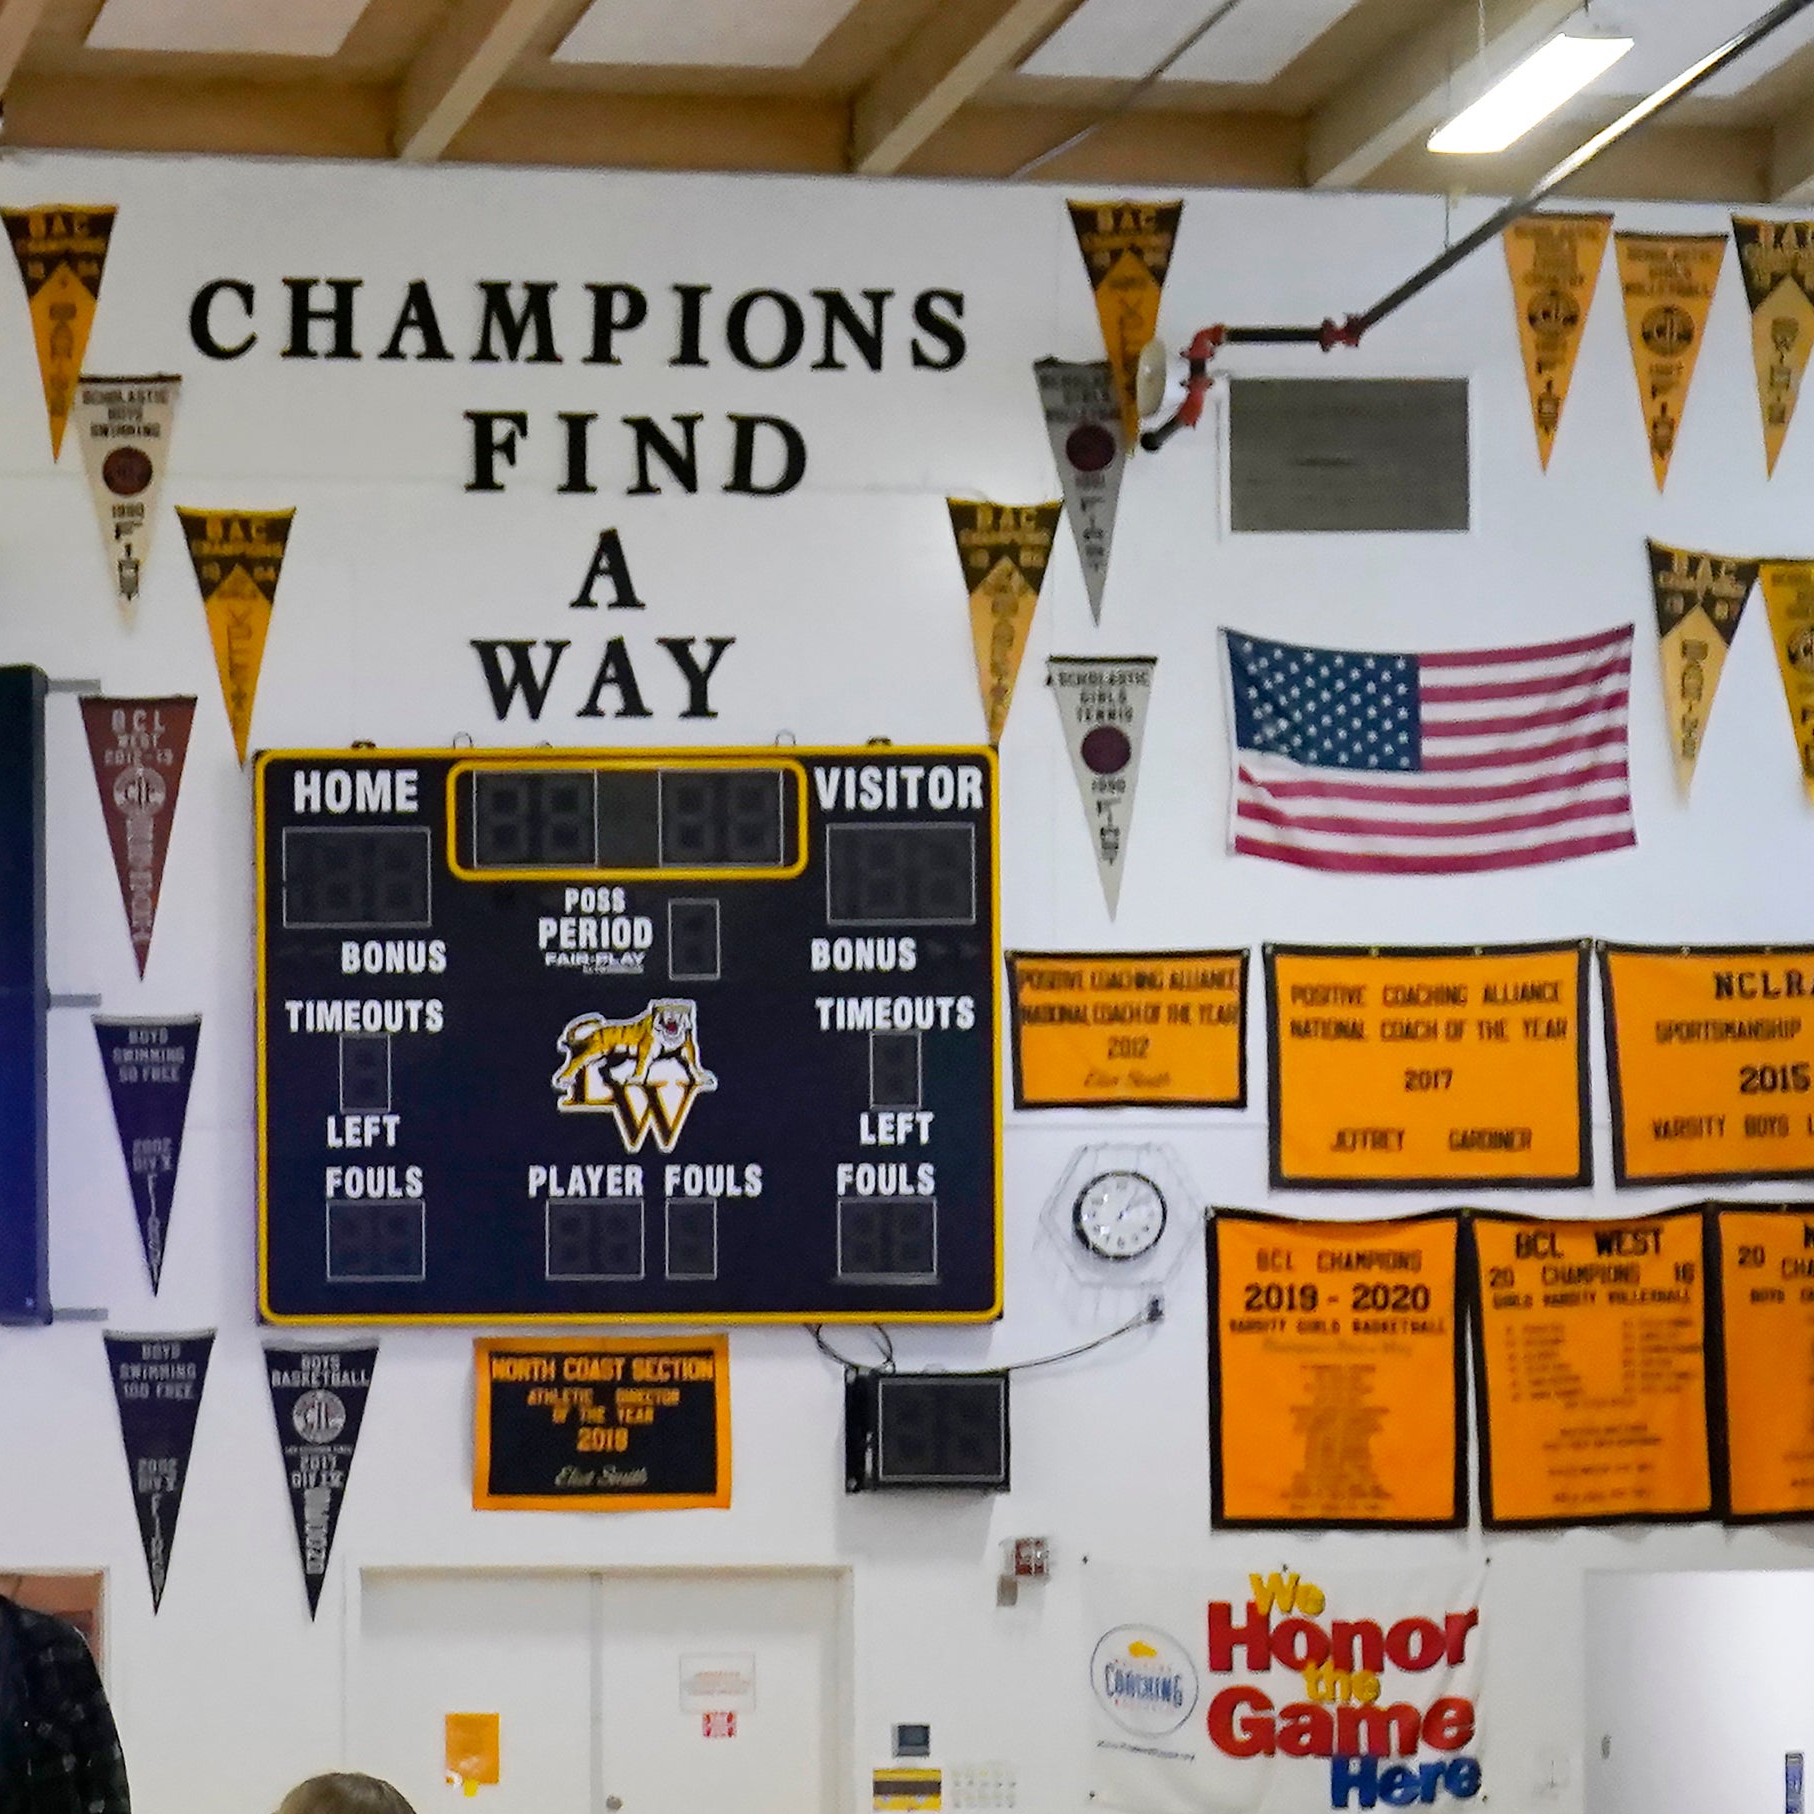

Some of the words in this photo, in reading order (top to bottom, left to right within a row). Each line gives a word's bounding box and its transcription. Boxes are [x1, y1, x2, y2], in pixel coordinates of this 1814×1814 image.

[189, 278, 968, 371] CHAMPIONS
[463, 411, 806, 495] FIND
[569, 528, 645, 609] A
[470, 635, 735, 721] WAY
[294, 769, 419, 812] HOME
[815, 766, 983, 810] VISITOR
[564, 887, 625, 914] POSS
[341, 941, 447, 974] BONUS
[811, 939, 916, 971] BONUS
[538, 917, 653, 950] PERIOD
[285, 1000, 444, 1033] TIMEOUTS
[815, 997, 975, 1031] TIMEOUTS
[1404, 1067, 1453, 1092] 2017
[1740, 1062, 1811, 1095] 2015
[327, 1114, 401, 1148] LEFT
[859, 1112, 934, 1145] LEFT
[325, 1166, 423, 1198] FOULS
[528, 1165, 644, 1198] PLAYER
[665, 1164, 764, 1198] FOULS
[837, 1163, 936, 1196] FOULS
[1245, 1281, 1319, 1313] 2019
[1351, 1281, 1431, 1313] 2020
[1249, 1572, 1326, 1618] We
[1208, 1601, 1479, 1674] Honor
[1302, 1659, 1381, 1705] the
[1207, 1685, 1477, 1759] Game
[1330, 1753, 1482, 1811] Here
